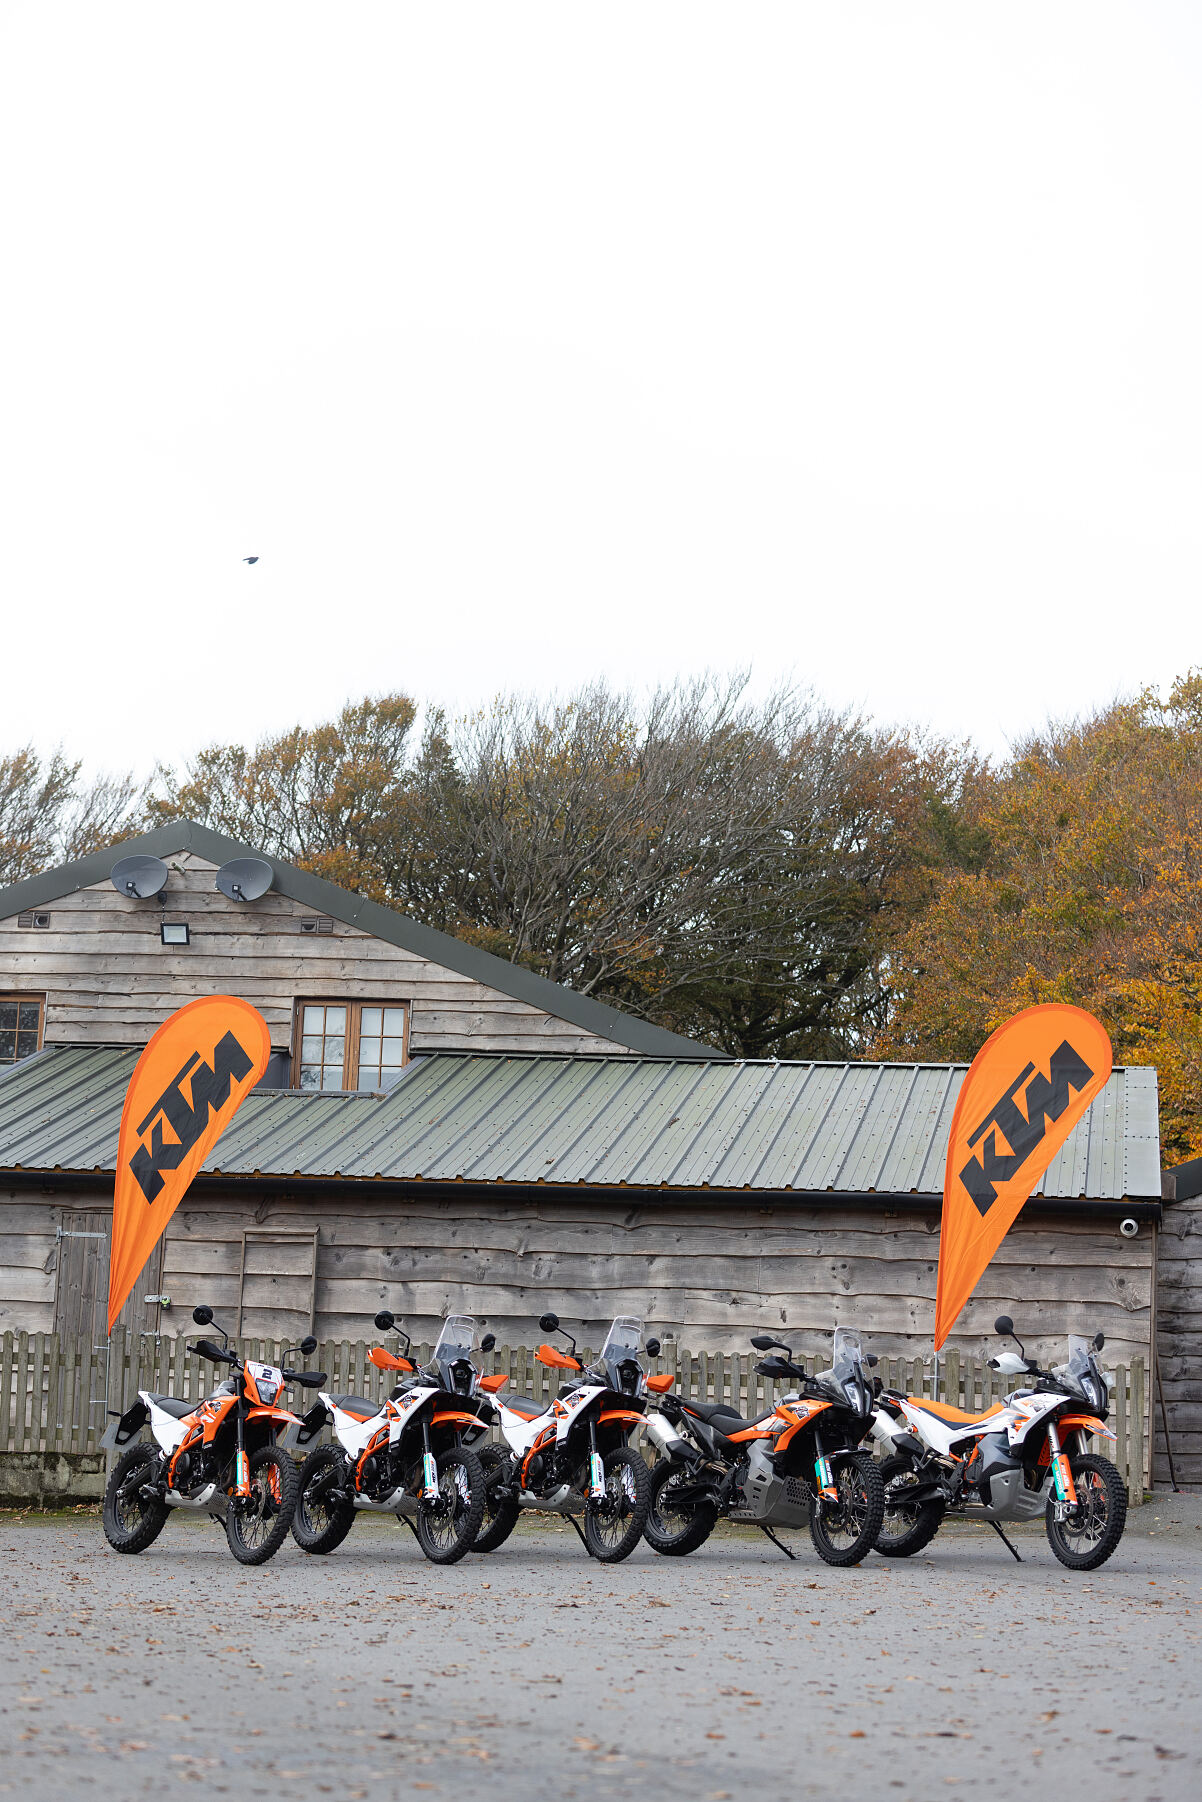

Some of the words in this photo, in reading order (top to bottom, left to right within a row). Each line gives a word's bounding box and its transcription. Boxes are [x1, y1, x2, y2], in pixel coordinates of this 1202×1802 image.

[129, 1030, 254, 1205] KTM
[959, 1039, 1094, 1217] KTM
[262, 1368, 272, 1380] 2
